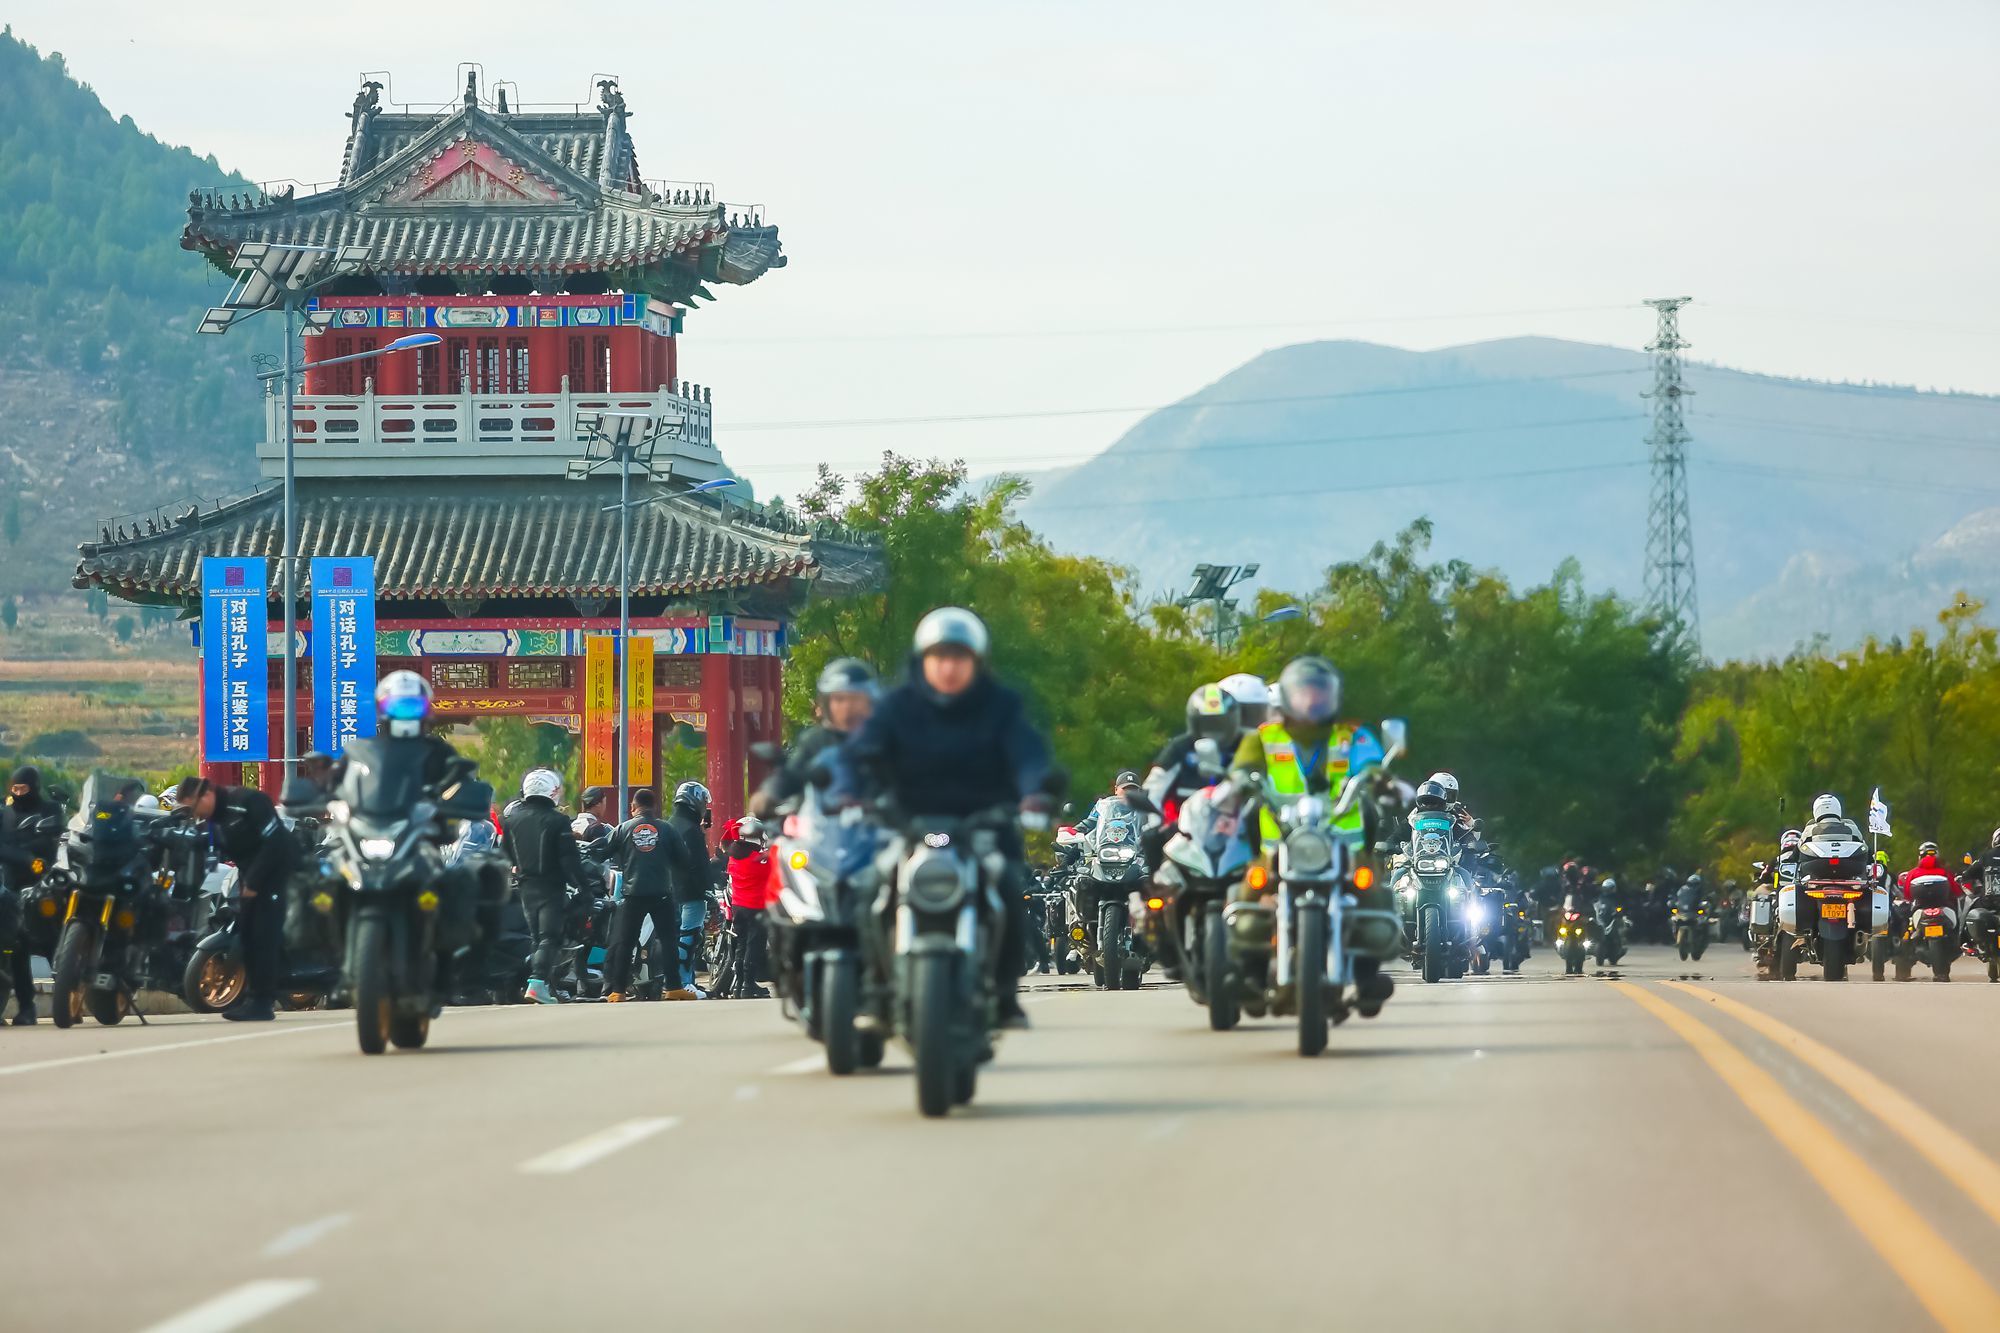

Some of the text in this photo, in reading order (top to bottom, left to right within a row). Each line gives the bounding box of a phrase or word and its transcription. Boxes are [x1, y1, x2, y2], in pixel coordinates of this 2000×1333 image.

[230, 598, 249, 751] 对话孔子 互鉴文明
[339, 599, 357, 669] 对话孔子
